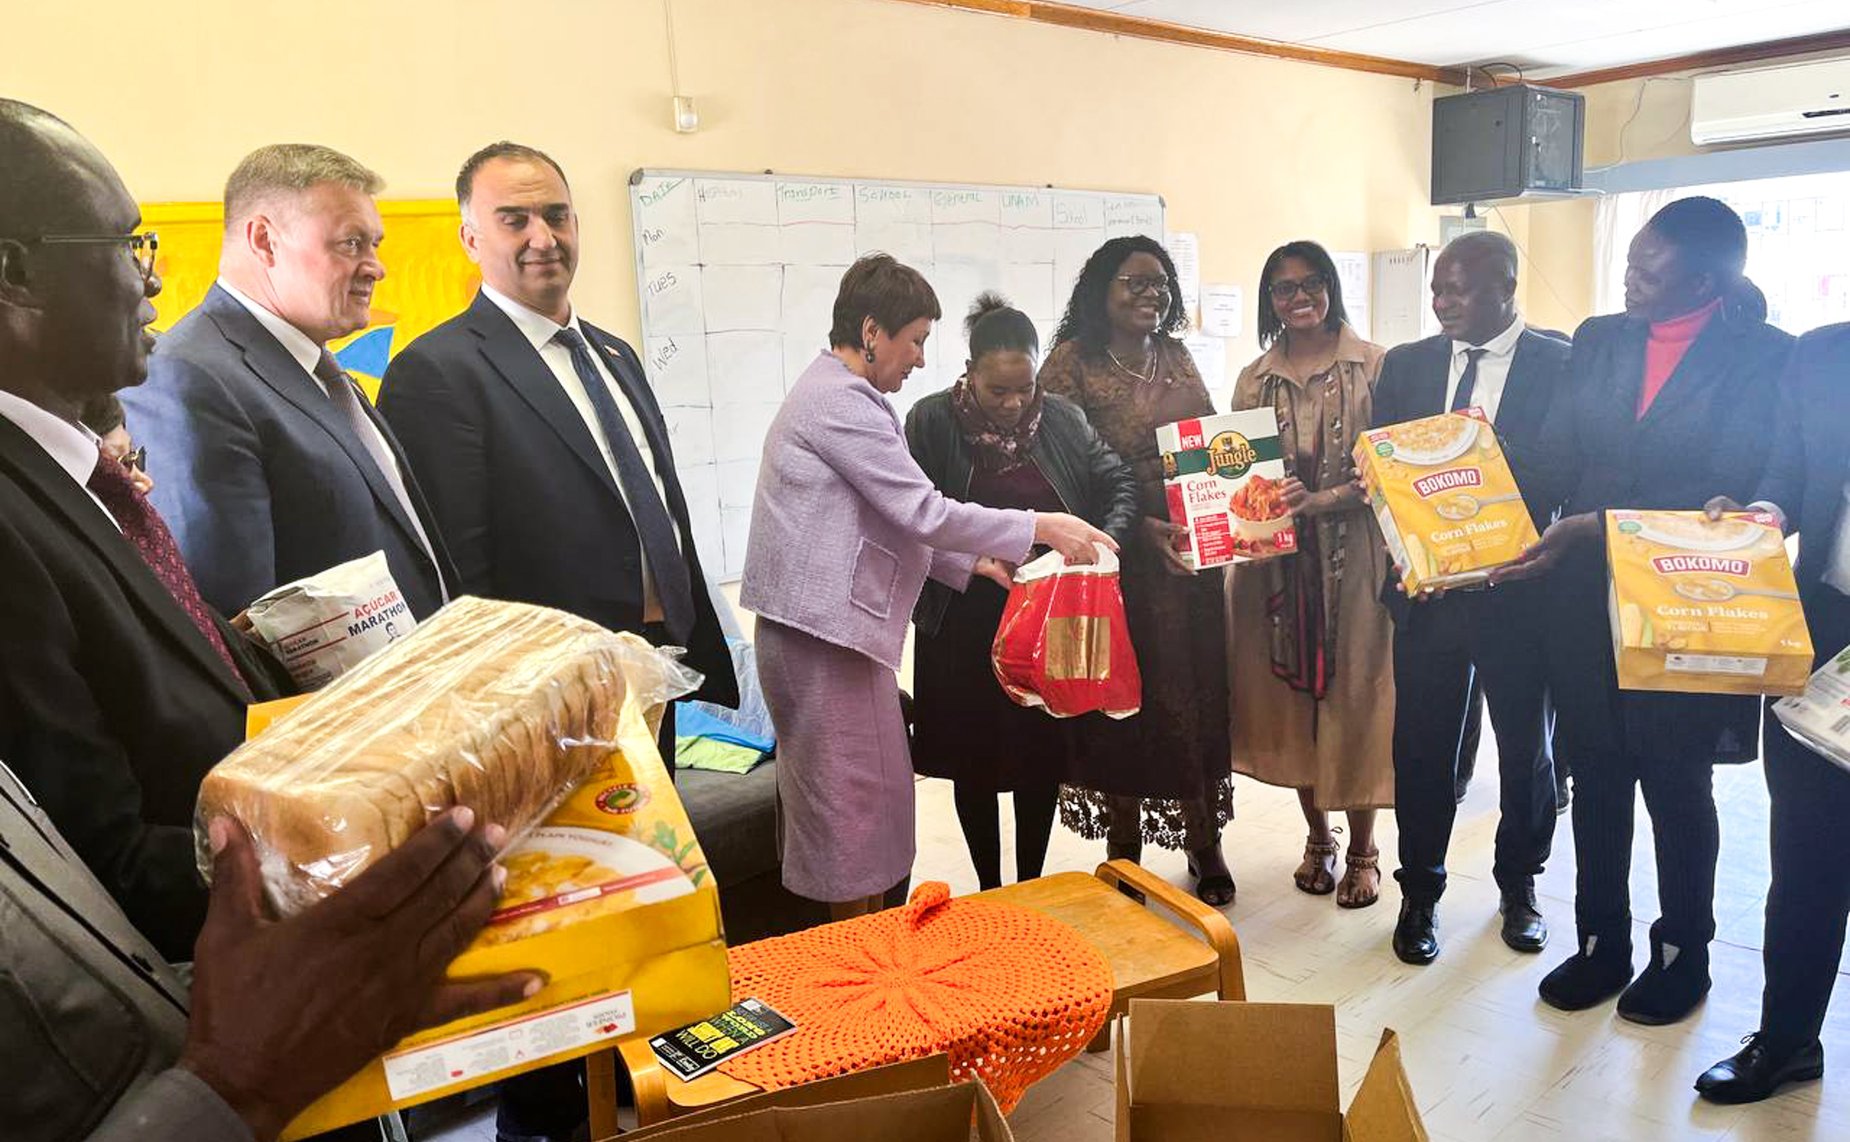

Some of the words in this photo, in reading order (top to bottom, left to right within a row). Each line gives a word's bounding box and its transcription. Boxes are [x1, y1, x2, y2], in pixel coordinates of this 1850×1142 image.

[1181, 434, 1203, 450] NEW
[1206, 443, 1258, 477] Jungle
[1187, 479, 1218, 493] Corn
[1417, 468, 1478, 495] BOKOMO
[1188, 489, 1227, 504] Flakes
[1430, 529, 1464, 544] Corn
[1661, 557, 1745, 574] BOKOMO
[1656, 604, 1703, 617] Corn
[1707, 606, 1769, 620] Flakes
